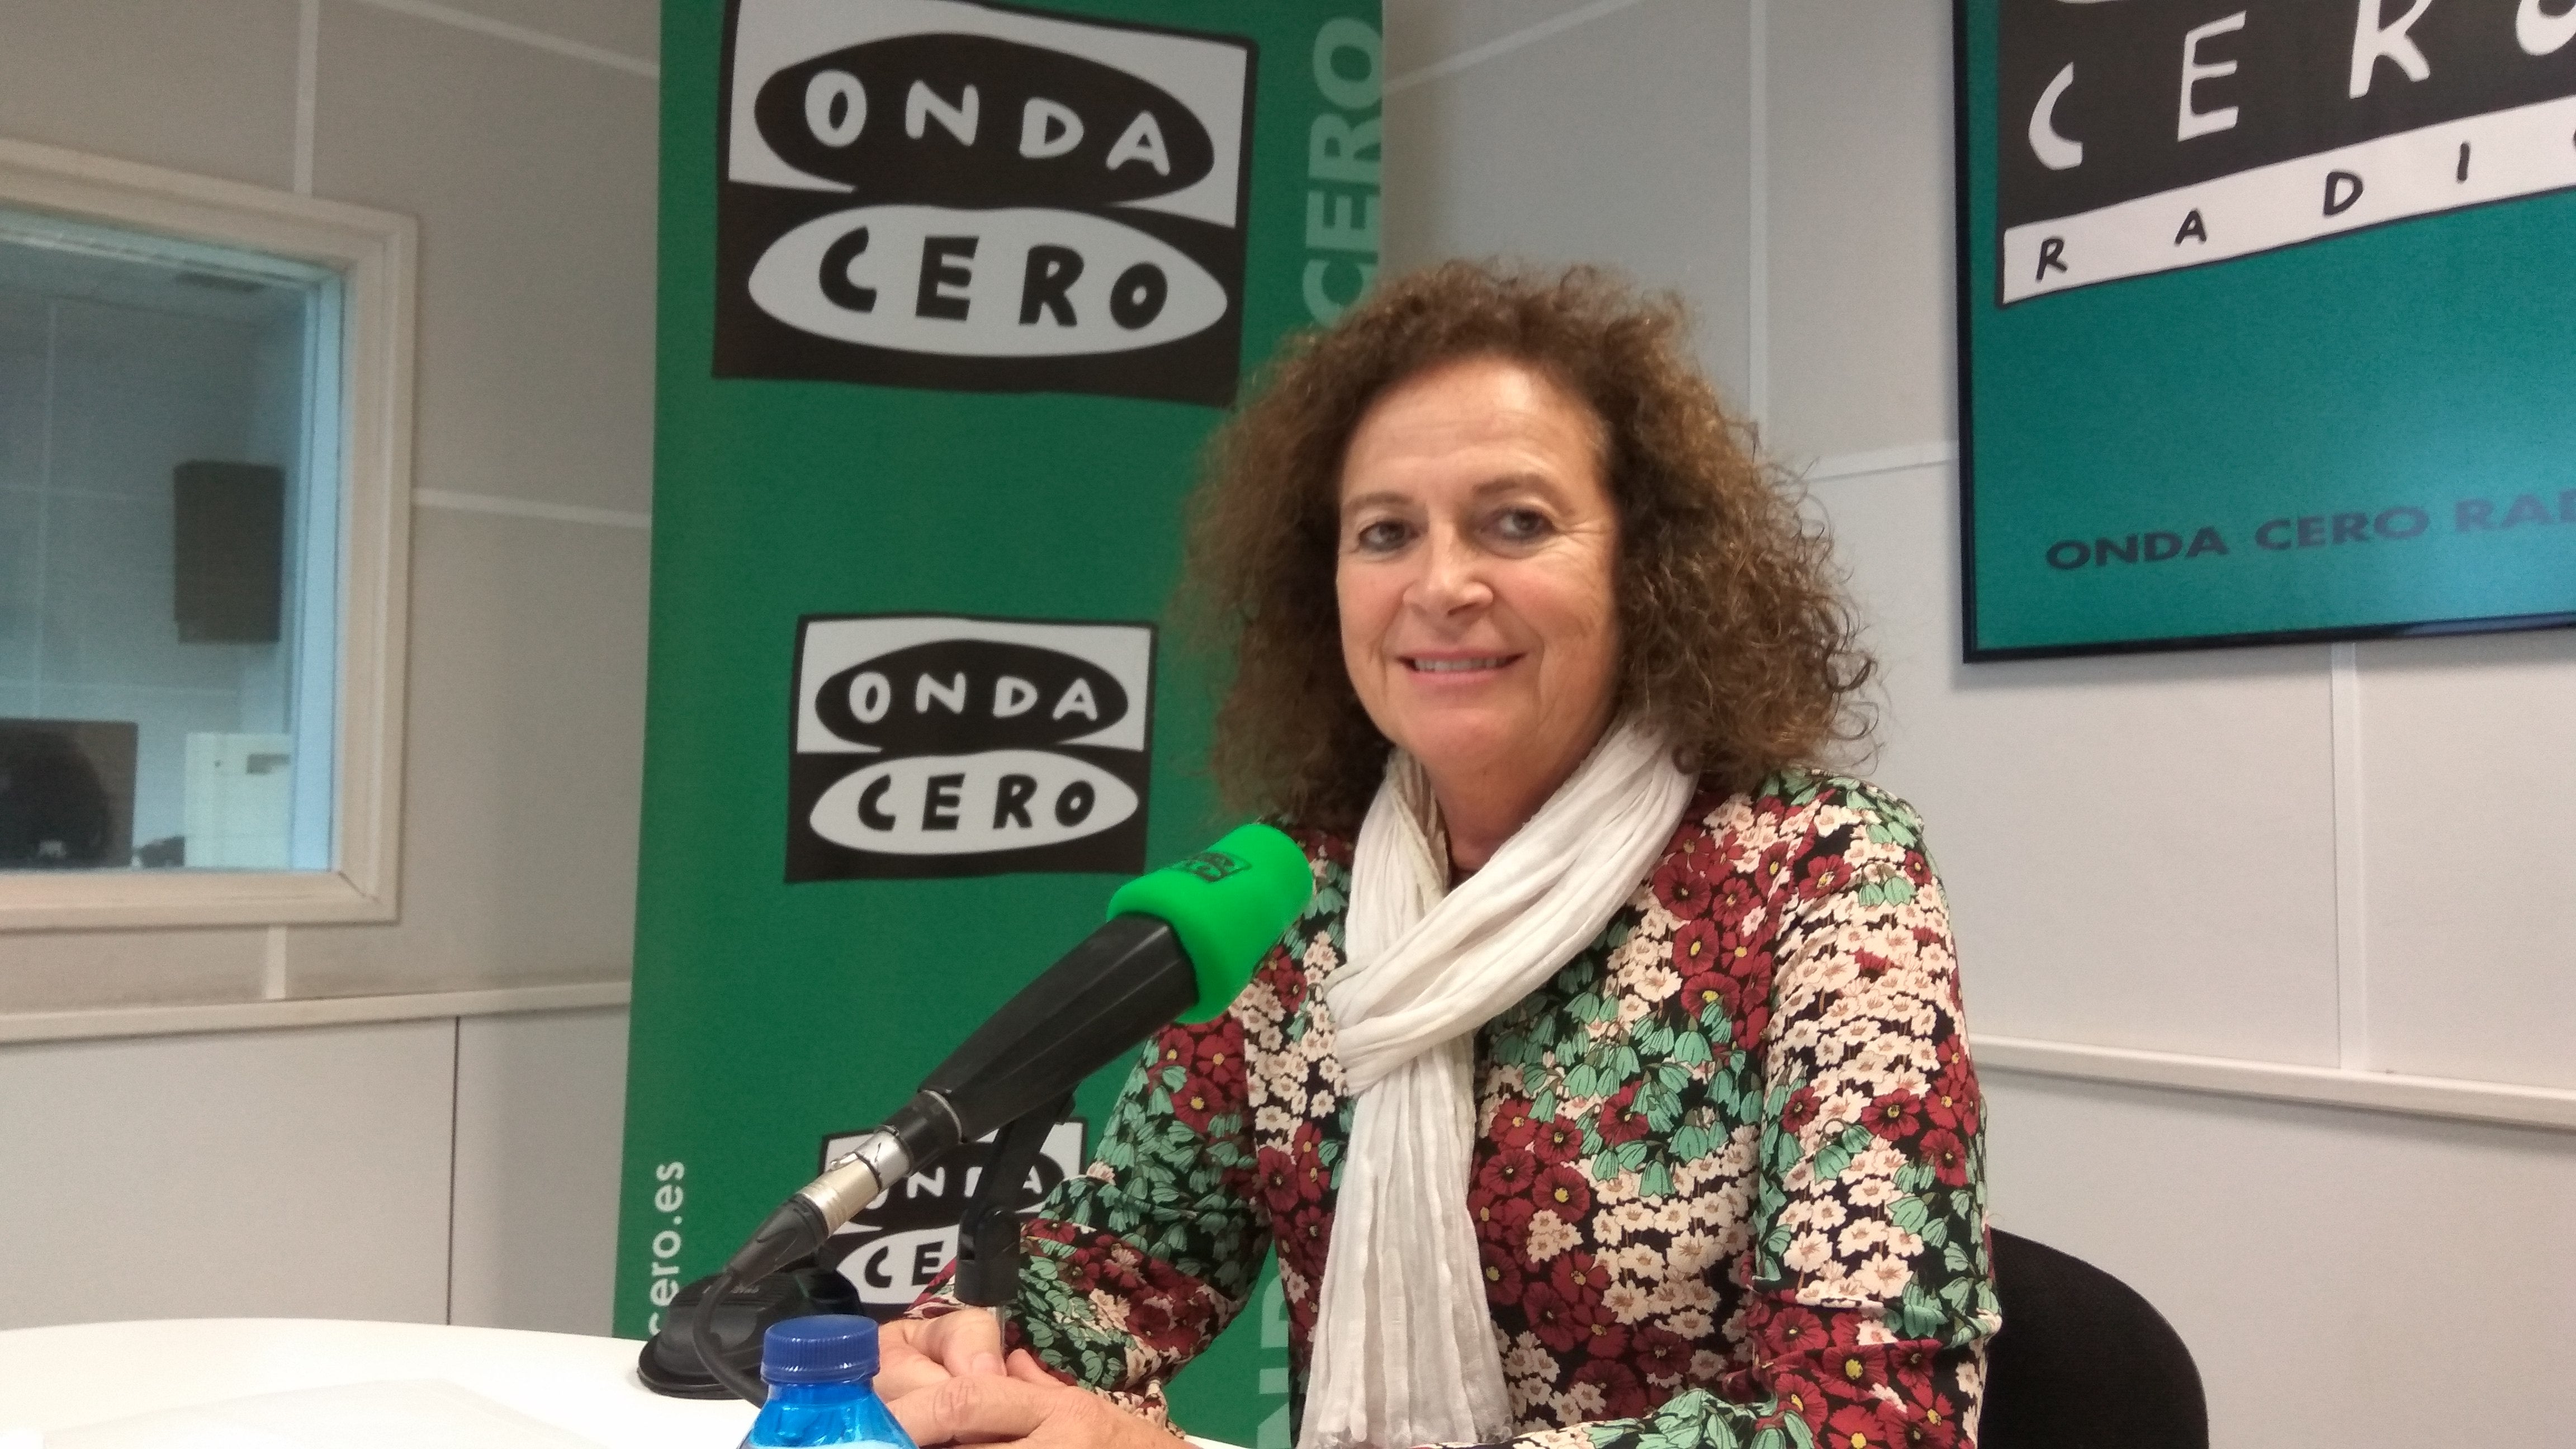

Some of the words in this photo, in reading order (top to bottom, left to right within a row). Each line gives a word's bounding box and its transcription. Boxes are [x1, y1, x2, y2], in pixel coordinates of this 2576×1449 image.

[804, 69, 1170, 176] ONDA
[1303, 17, 1382, 330] CERO
[2036, 127, 2576, 282] RADI
[819, 226, 1167, 330] CERO
[2045, 526, 2229, 570] ONDA
[2255, 506, 2430, 551] CERO
[849, 671, 1098, 723] ONDA
[858, 774, 1095, 831] CERO
